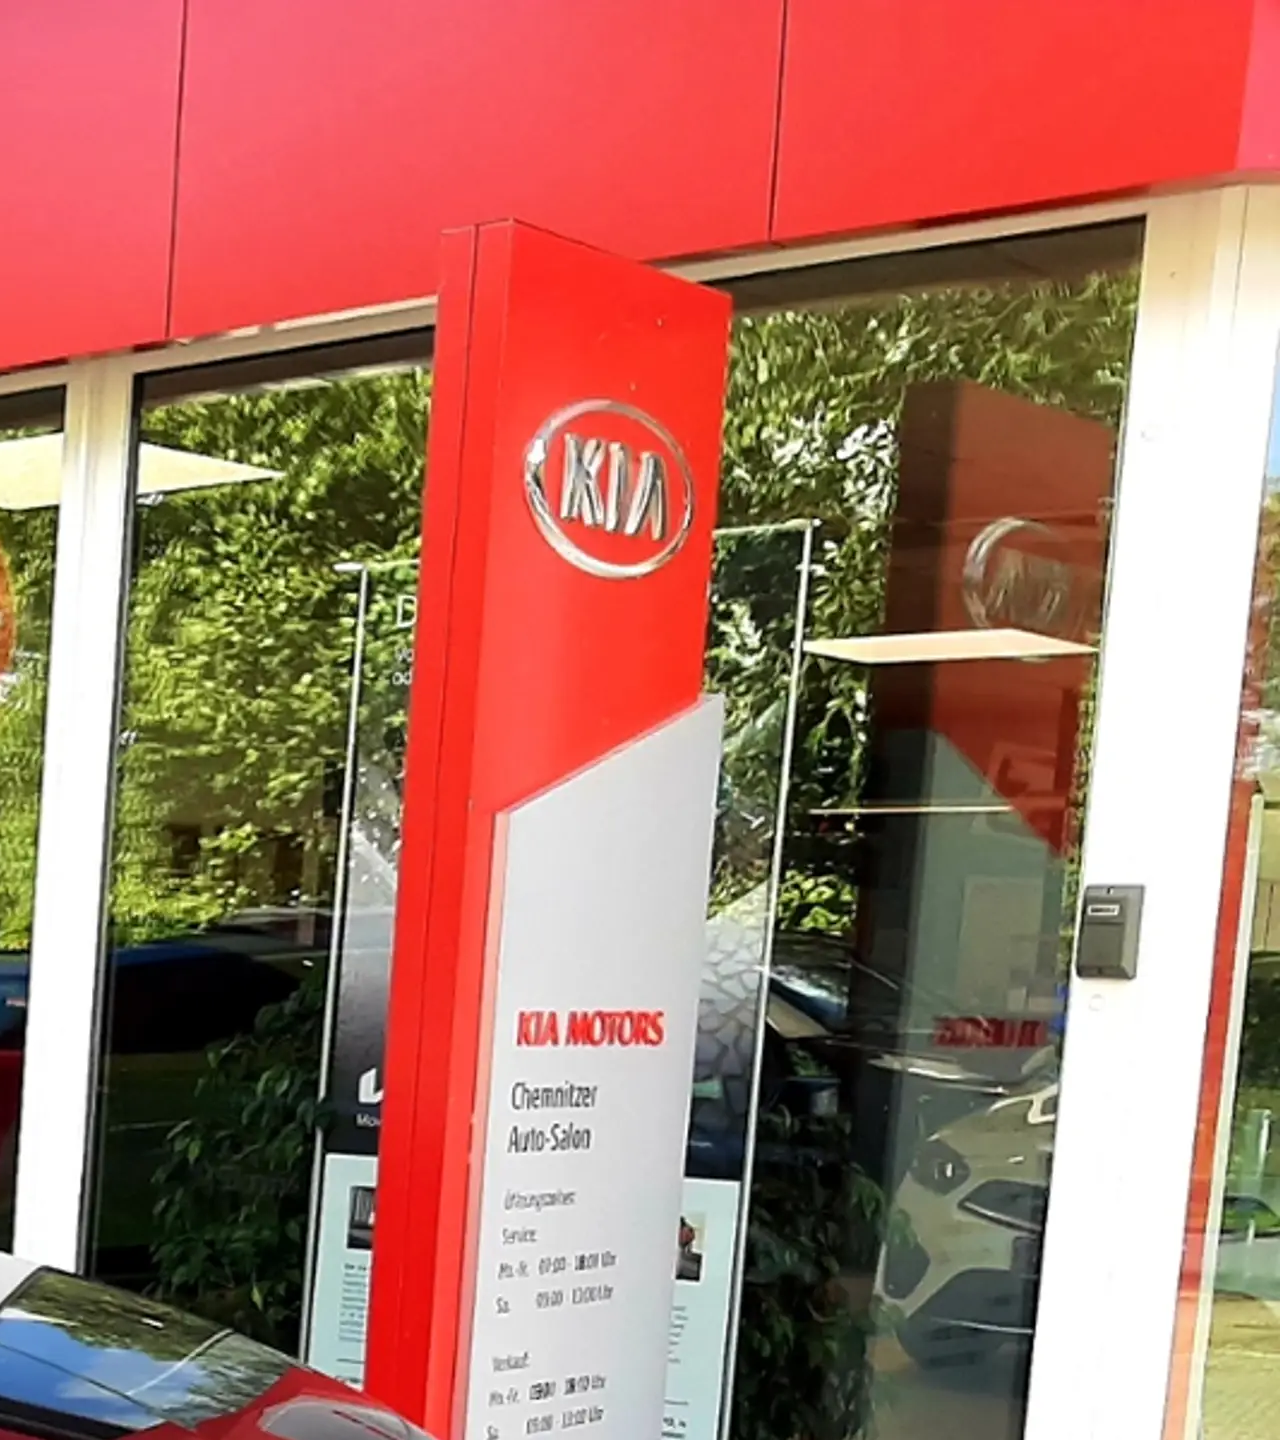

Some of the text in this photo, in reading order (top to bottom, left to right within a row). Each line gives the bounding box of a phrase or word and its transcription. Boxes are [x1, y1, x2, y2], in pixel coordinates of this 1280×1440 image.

[560, 433, 666, 541] KIA
[516, 1011, 665, 1047] KIA MOTORS
[511, 1081, 598, 1110] Chemnitzer
[507, 1122, 592, 1153] Auto-Salon
